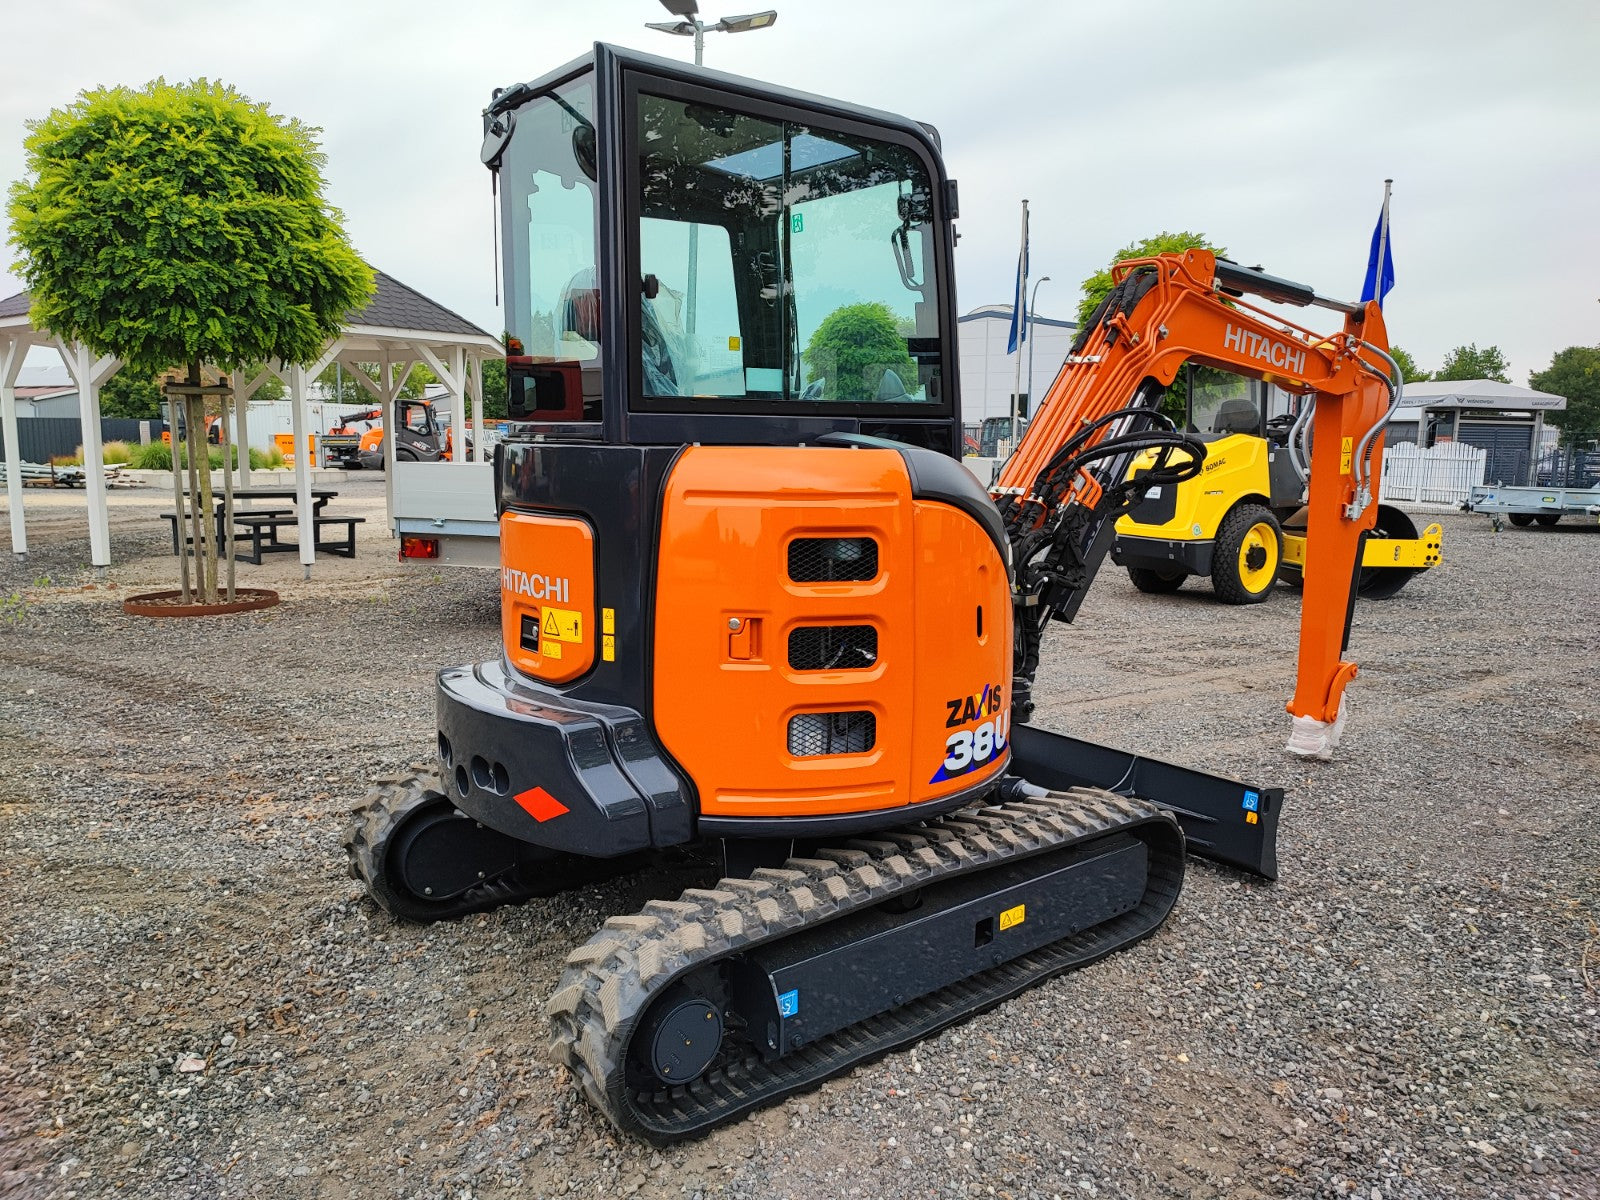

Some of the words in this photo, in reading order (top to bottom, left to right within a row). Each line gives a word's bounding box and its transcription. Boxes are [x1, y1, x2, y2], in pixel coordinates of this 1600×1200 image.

[1223, 323, 1306, 375] HITACHI
[502, 565, 569, 603] HITACHI
[945, 683, 1001, 729] ZAXIS
